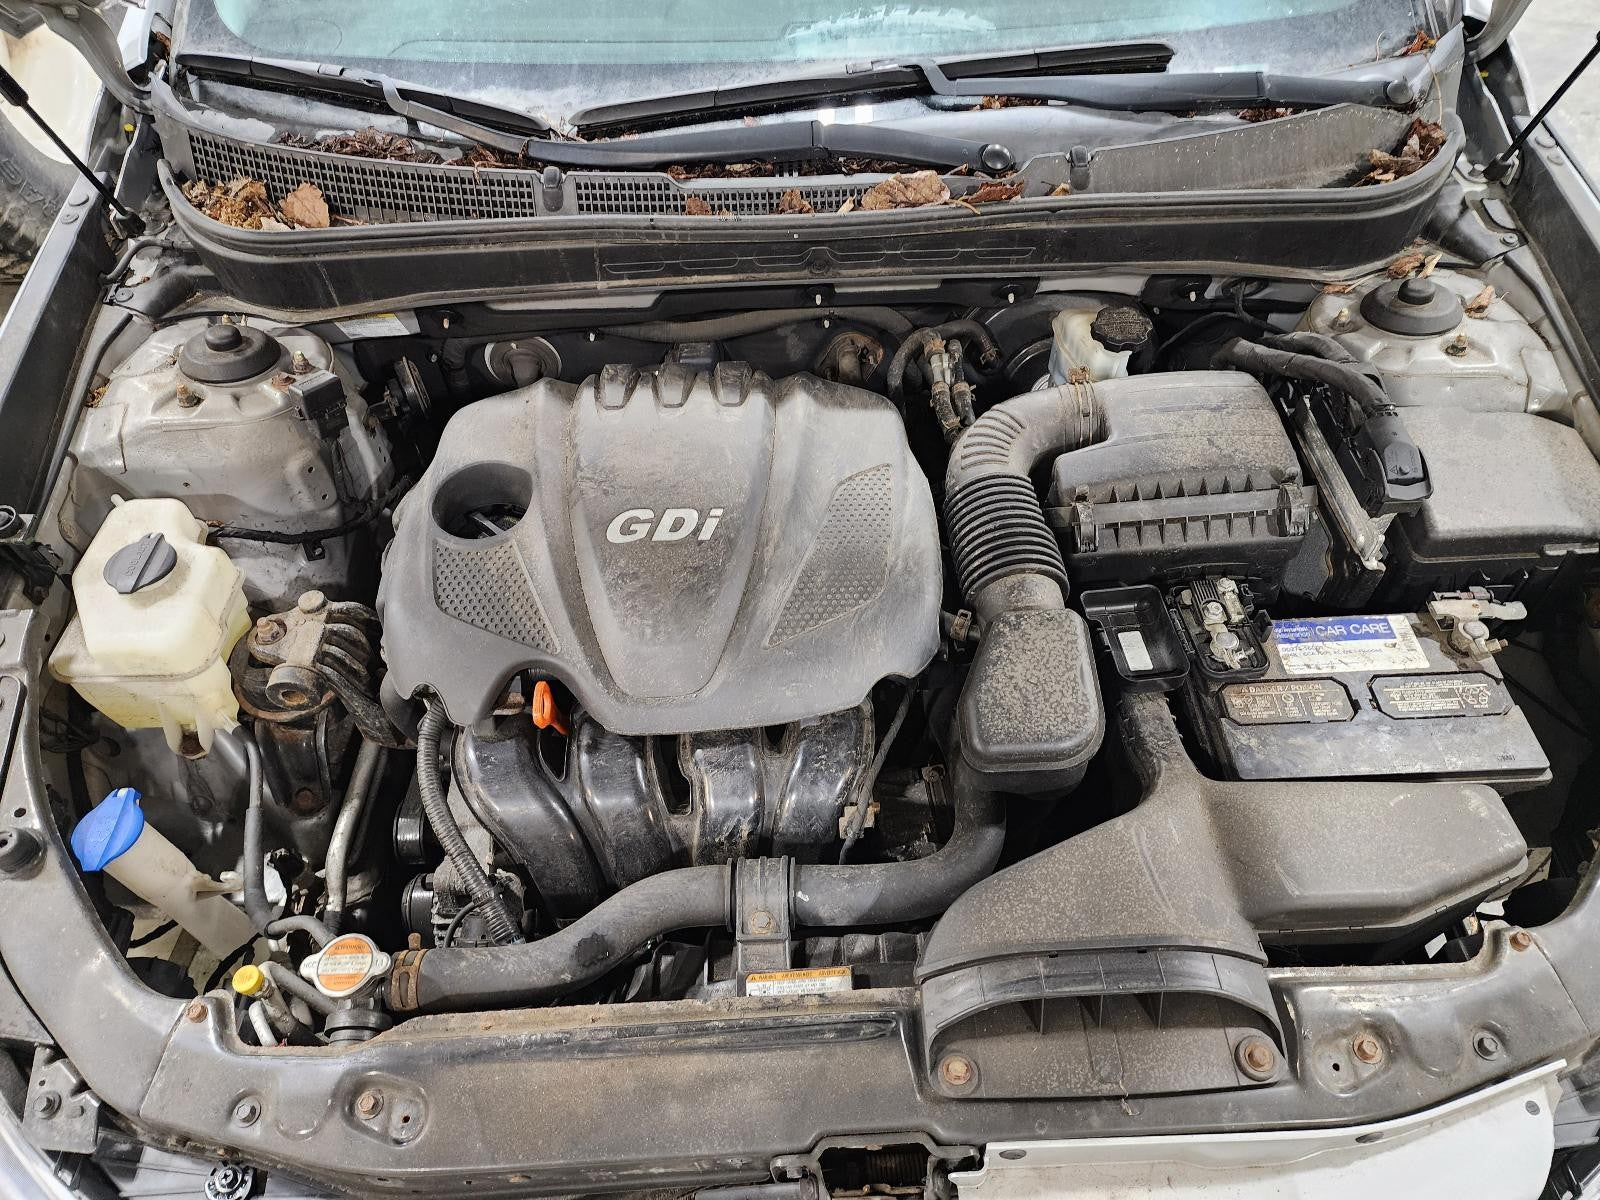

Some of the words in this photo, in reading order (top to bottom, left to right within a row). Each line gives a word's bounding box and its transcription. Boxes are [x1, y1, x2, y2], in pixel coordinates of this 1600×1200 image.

[606, 508, 724, 543] GDi
[1315, 624, 1347, 637] CAR
[1349, 622, 1392, 635] CARE
